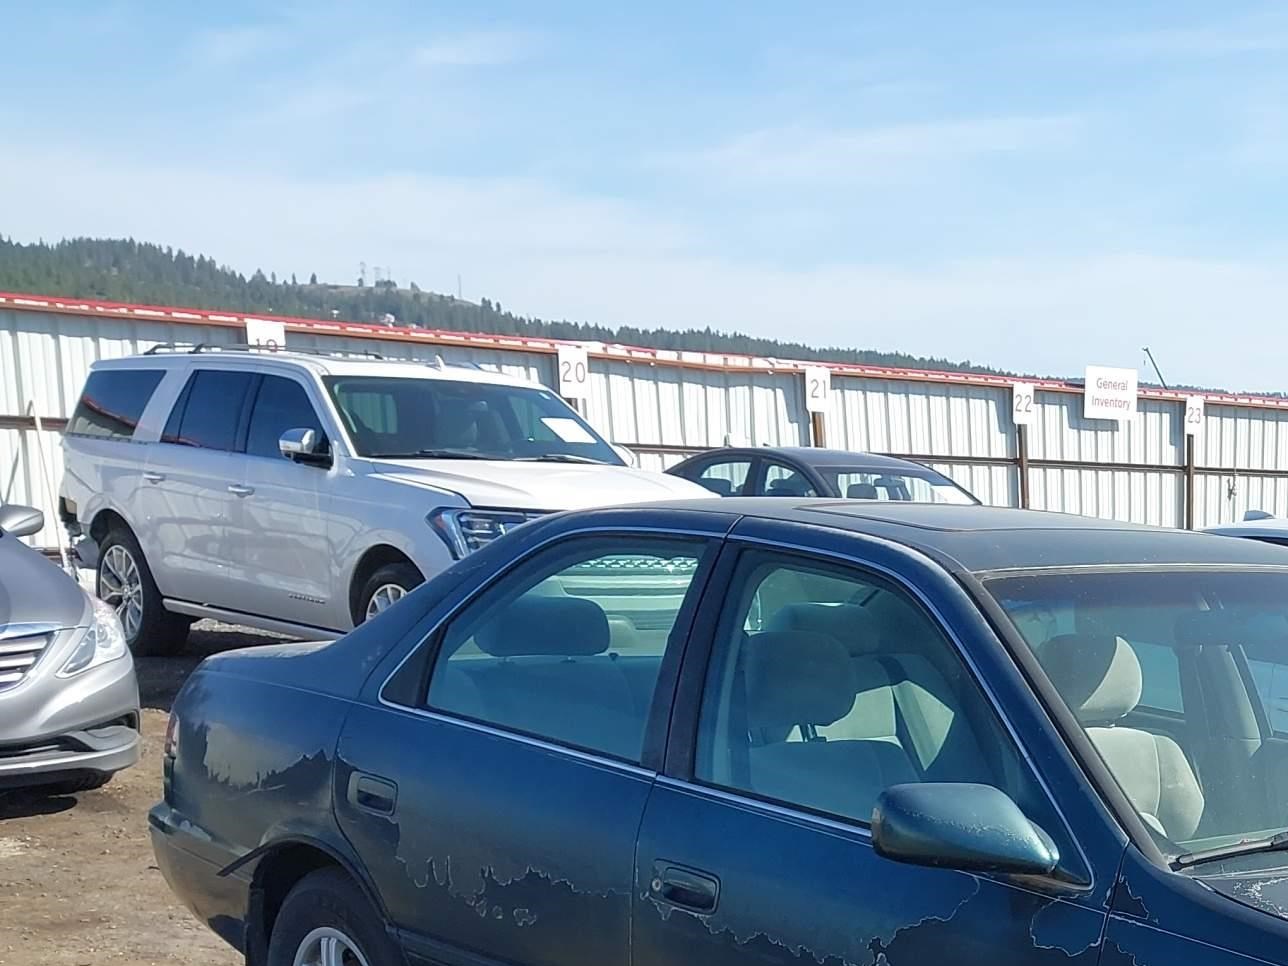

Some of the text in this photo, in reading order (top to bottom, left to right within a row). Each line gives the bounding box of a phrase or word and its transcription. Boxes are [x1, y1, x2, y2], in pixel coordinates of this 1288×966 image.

[561, 361, 585, 383] 20
[810, 378, 826, 399] 21
[1096, 377, 1129, 391] General
[1015, 393, 1032, 412] 22
[1091, 395, 1131, 411] Inventory
[1188, 406, 1201, 424] 23
